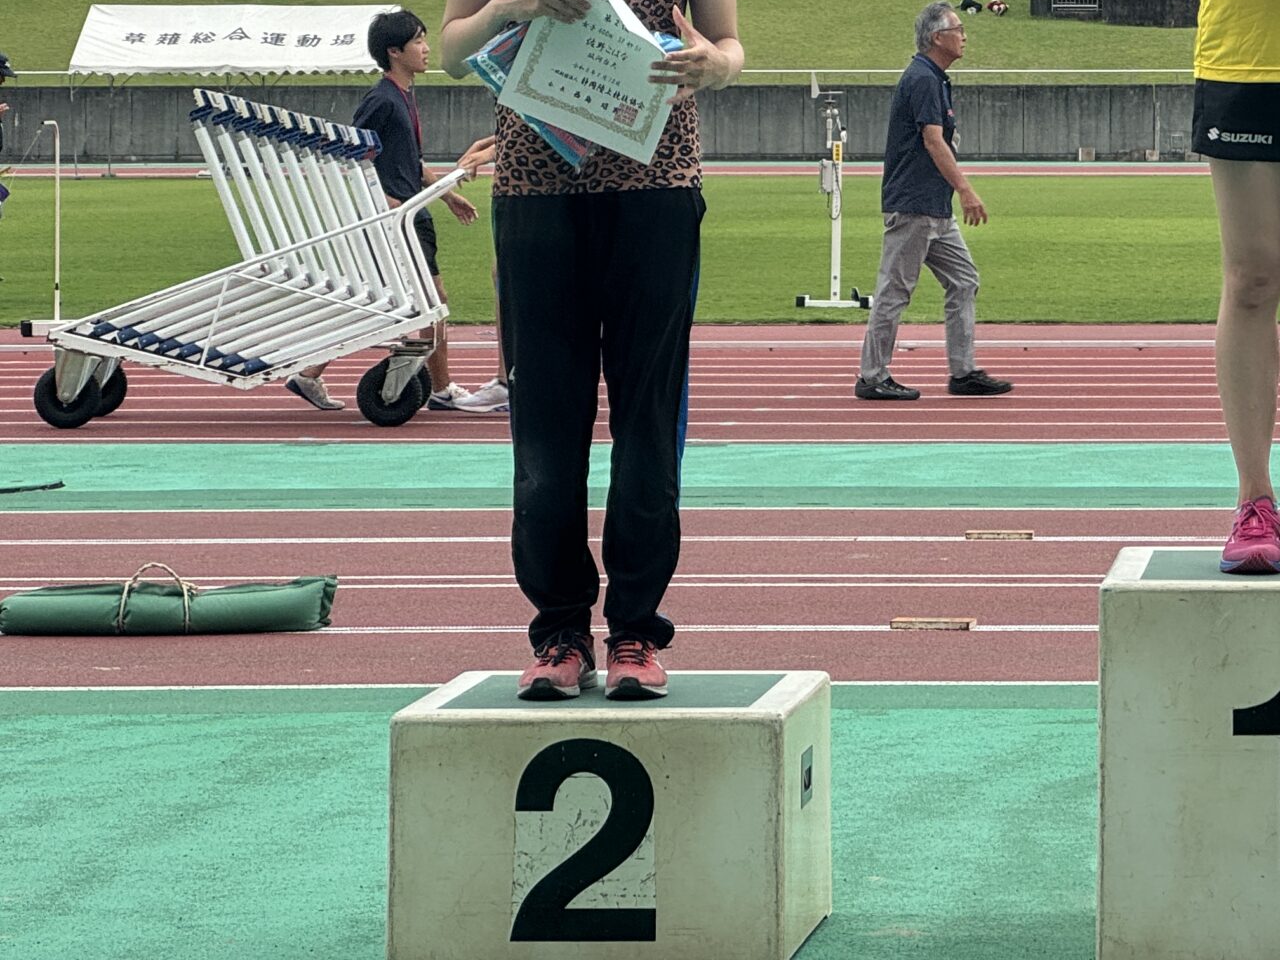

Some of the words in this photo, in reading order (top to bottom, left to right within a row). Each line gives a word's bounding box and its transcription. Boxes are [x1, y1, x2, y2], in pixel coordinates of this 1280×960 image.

[122, 27, 356, 48] 草薙総合運動場
[1220, 131, 1273, 145] SUZUKI
[509, 737, 656, 942] 2
